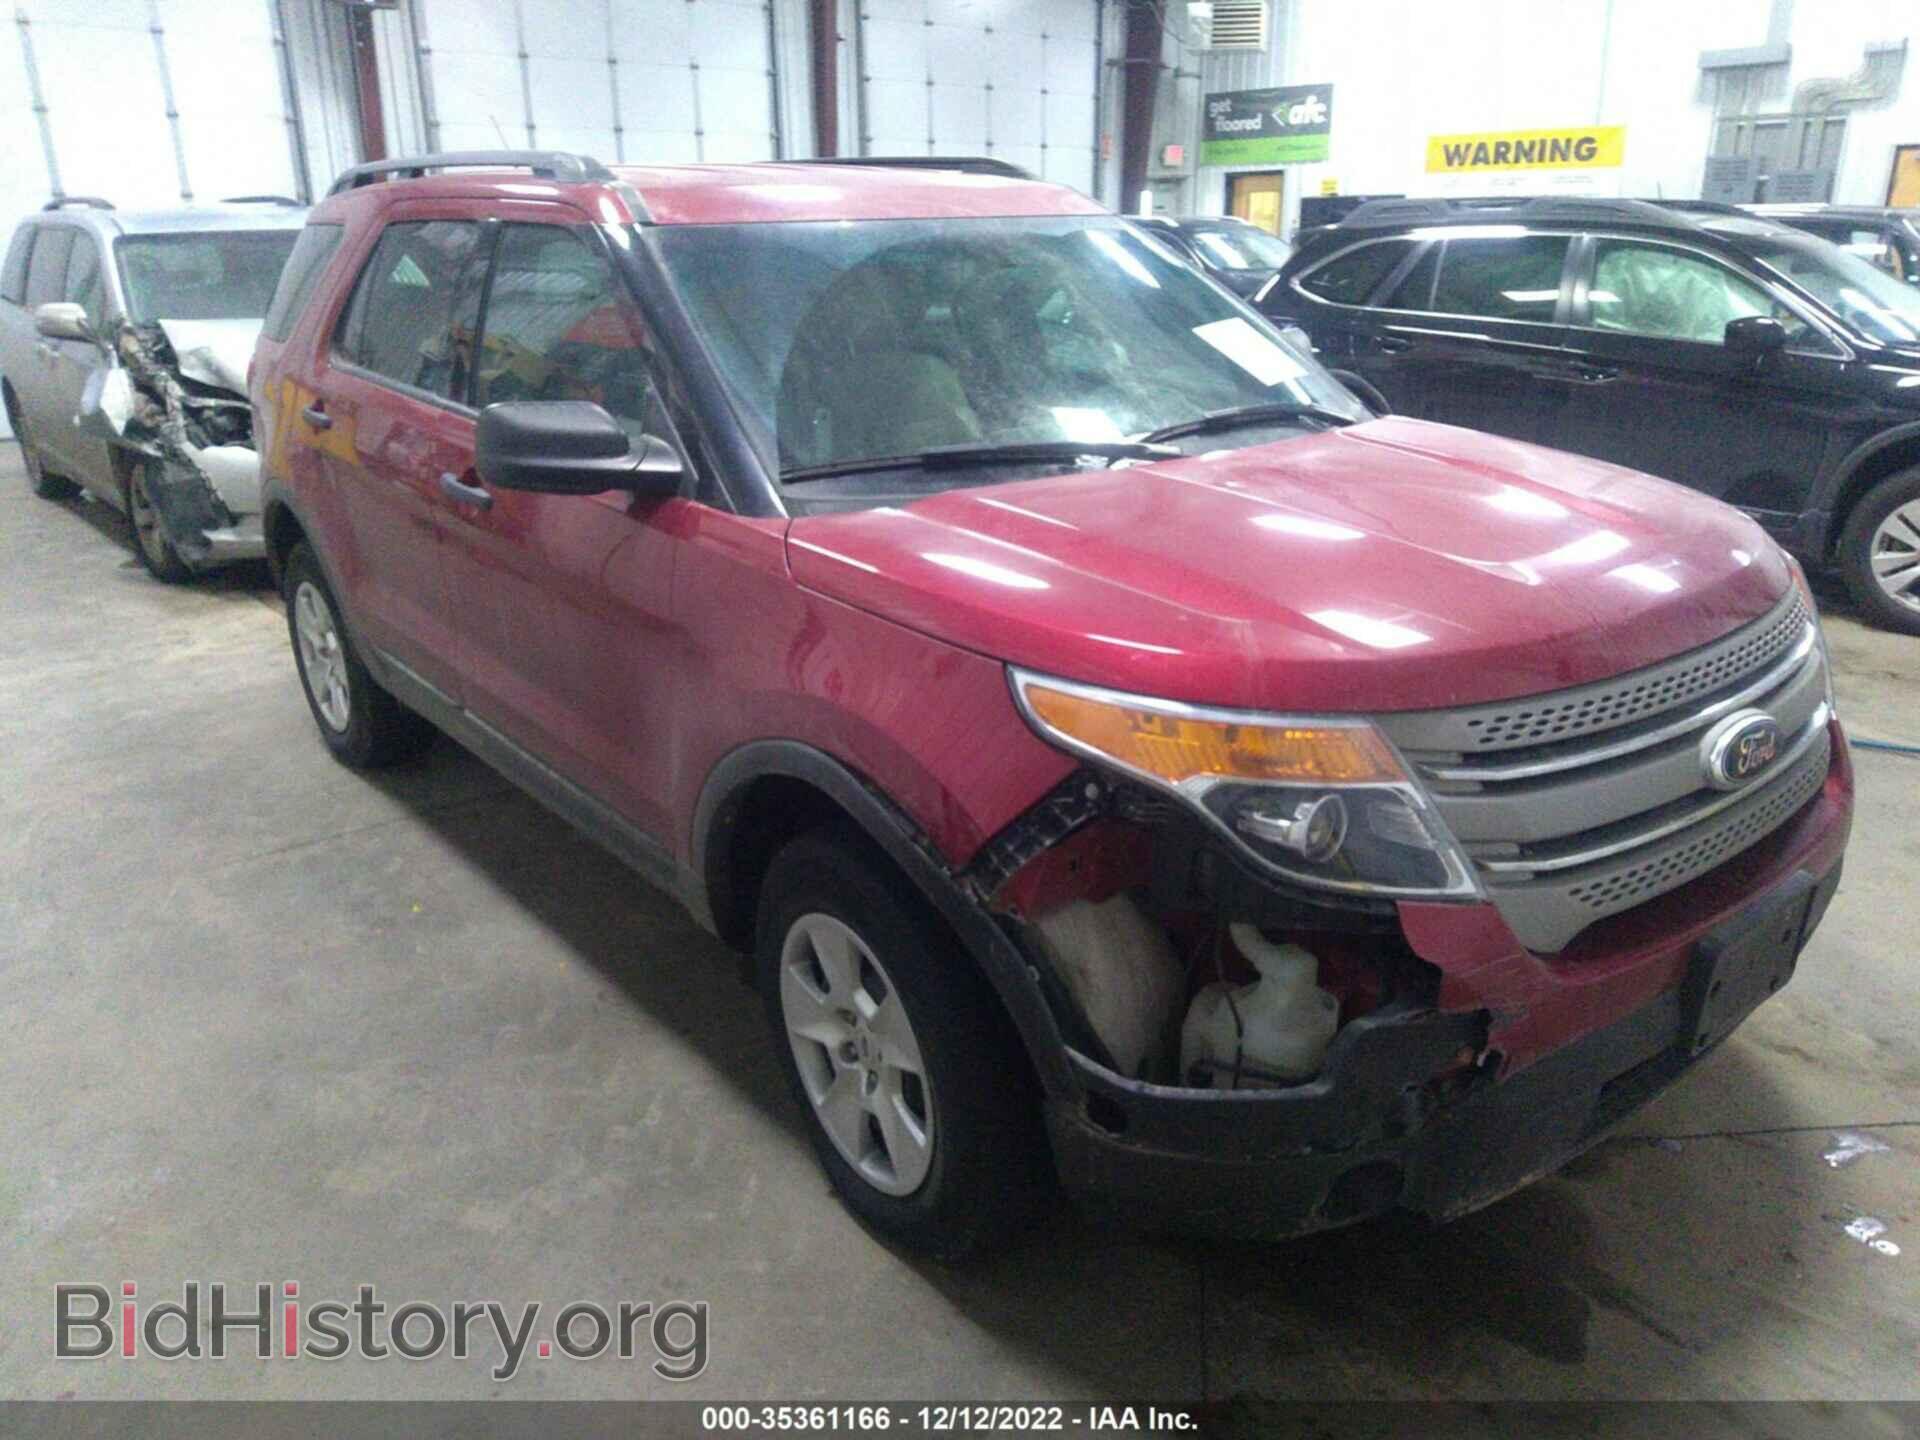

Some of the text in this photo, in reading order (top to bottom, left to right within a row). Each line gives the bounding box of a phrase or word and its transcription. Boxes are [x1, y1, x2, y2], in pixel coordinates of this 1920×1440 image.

[1208, 98, 1232, 118] get
[1215, 112, 1263, 132] floored
[1288, 95, 1328, 125] afc
[1442, 136, 1598, 168] WARNING
[1737, 728, 1777, 775] Ford
